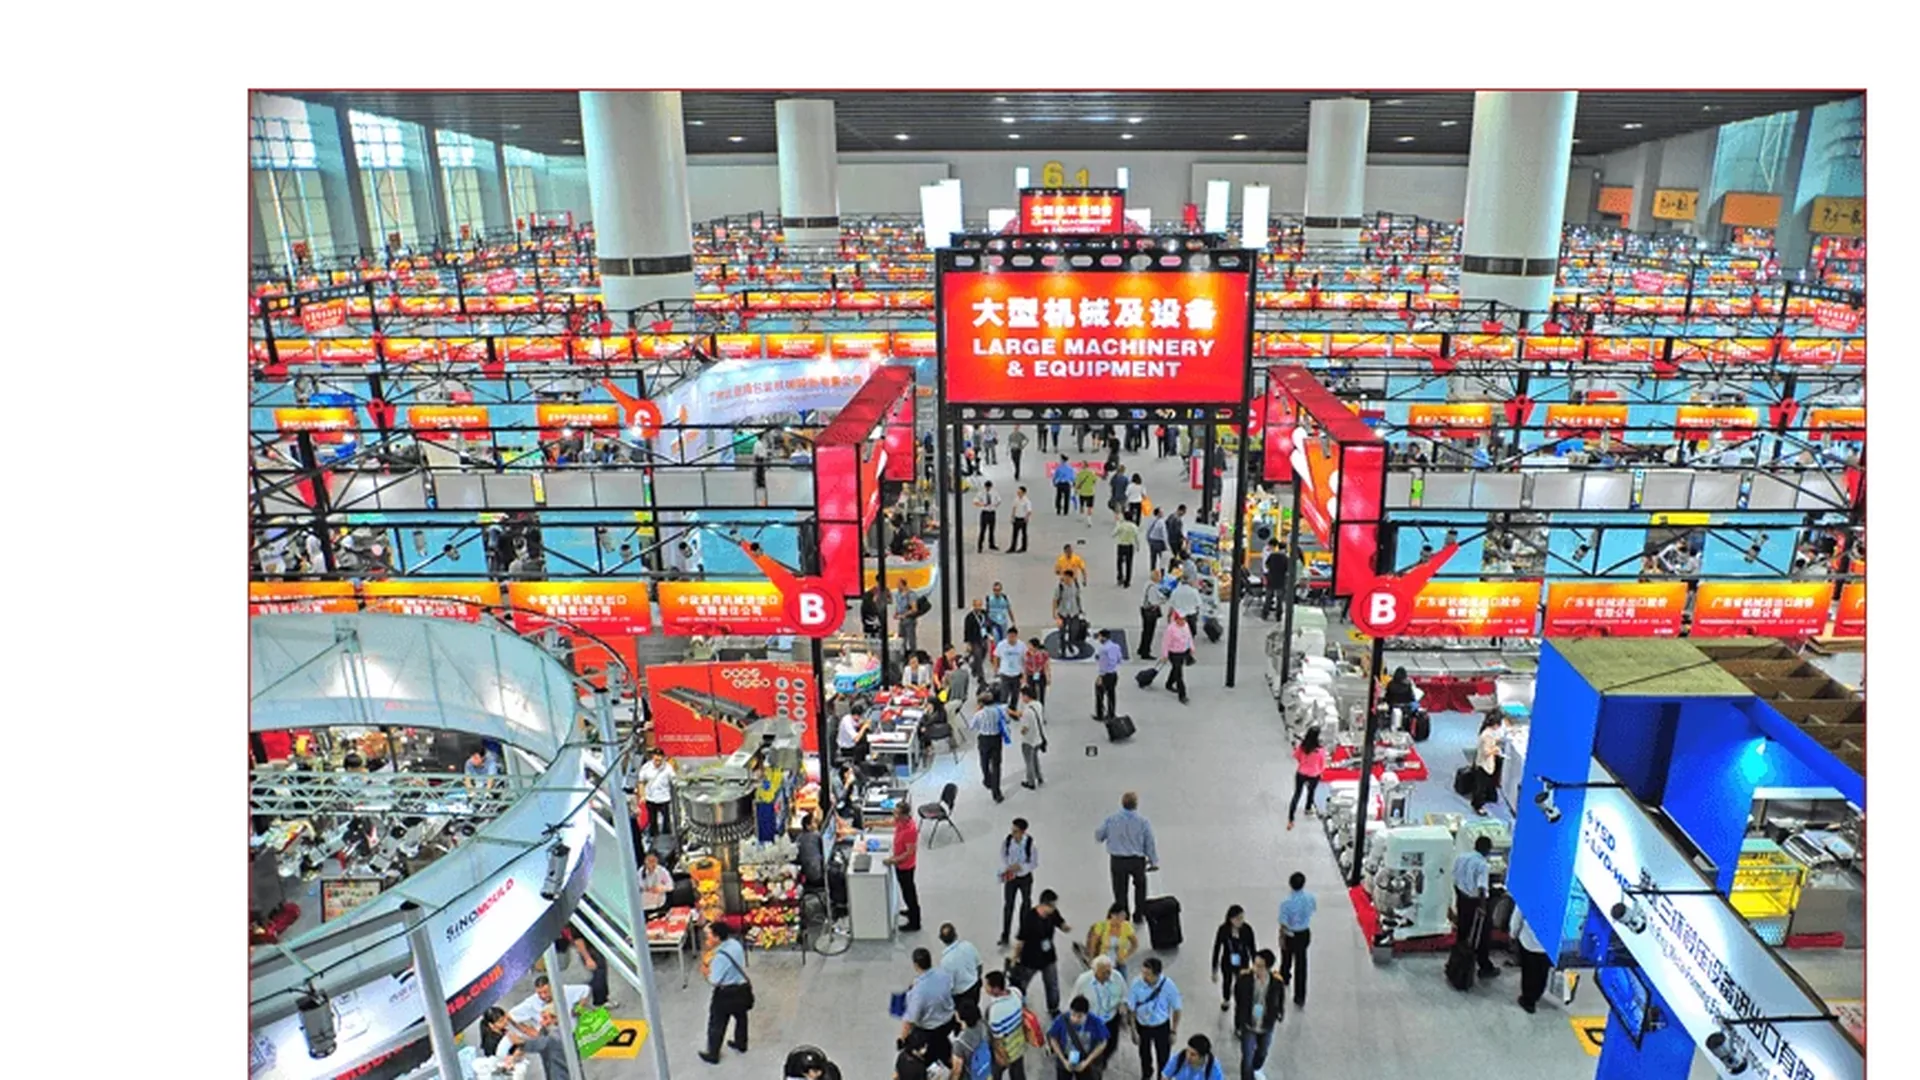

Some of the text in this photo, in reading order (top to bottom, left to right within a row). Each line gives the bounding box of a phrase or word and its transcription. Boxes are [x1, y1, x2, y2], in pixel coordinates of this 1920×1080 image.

[971, 297, 1218, 330] 大型机械及设备
[973, 338, 1215, 357] LARGE MACHINERY
[1006, 361, 1182, 378] & EQUIPMENT
[634, 409, 651, 432] C
[799, 593, 826, 625] B
[1369, 593, 1397, 625] B
